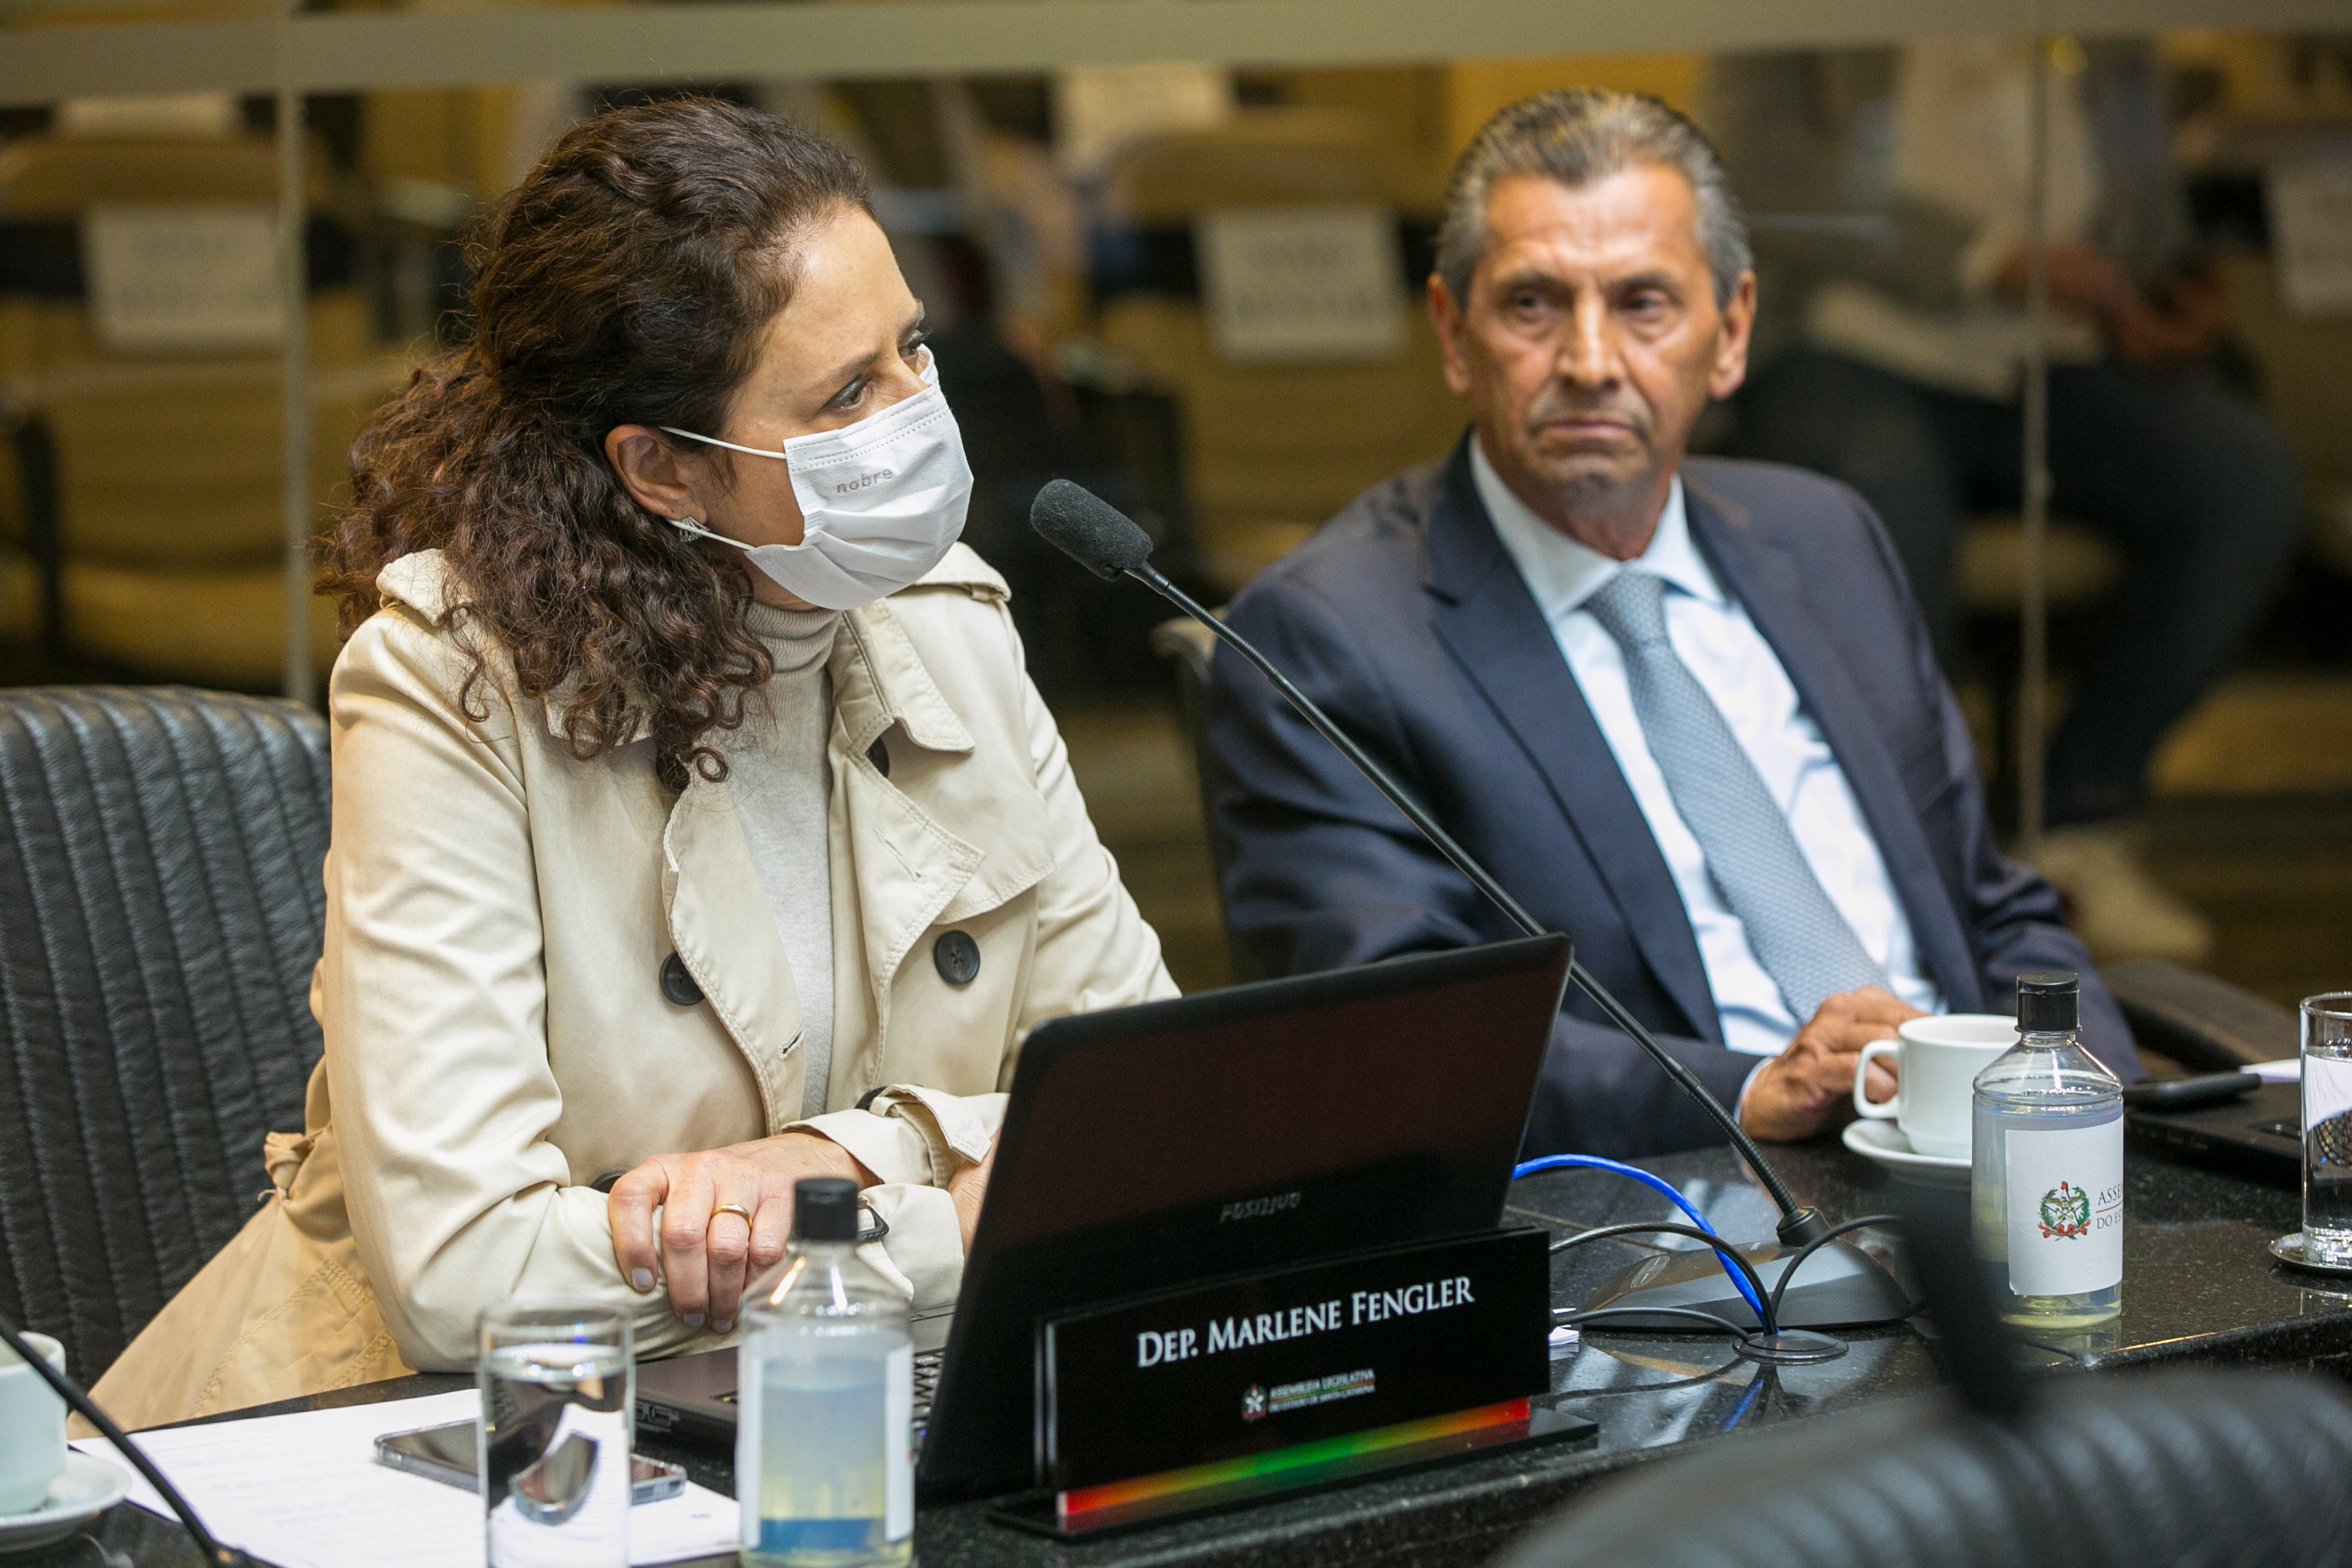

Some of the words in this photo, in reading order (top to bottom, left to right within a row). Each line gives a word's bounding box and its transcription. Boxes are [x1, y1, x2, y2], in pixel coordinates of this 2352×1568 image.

[837, 469, 893, 493] nobre
[2098, 1183, 2122, 1205] ASSE
[2097, 1215, 2113, 1229] DO
[1206, 1299, 1342, 1355] MARLENE
[1351, 1276, 1475, 1326] FENGLER
